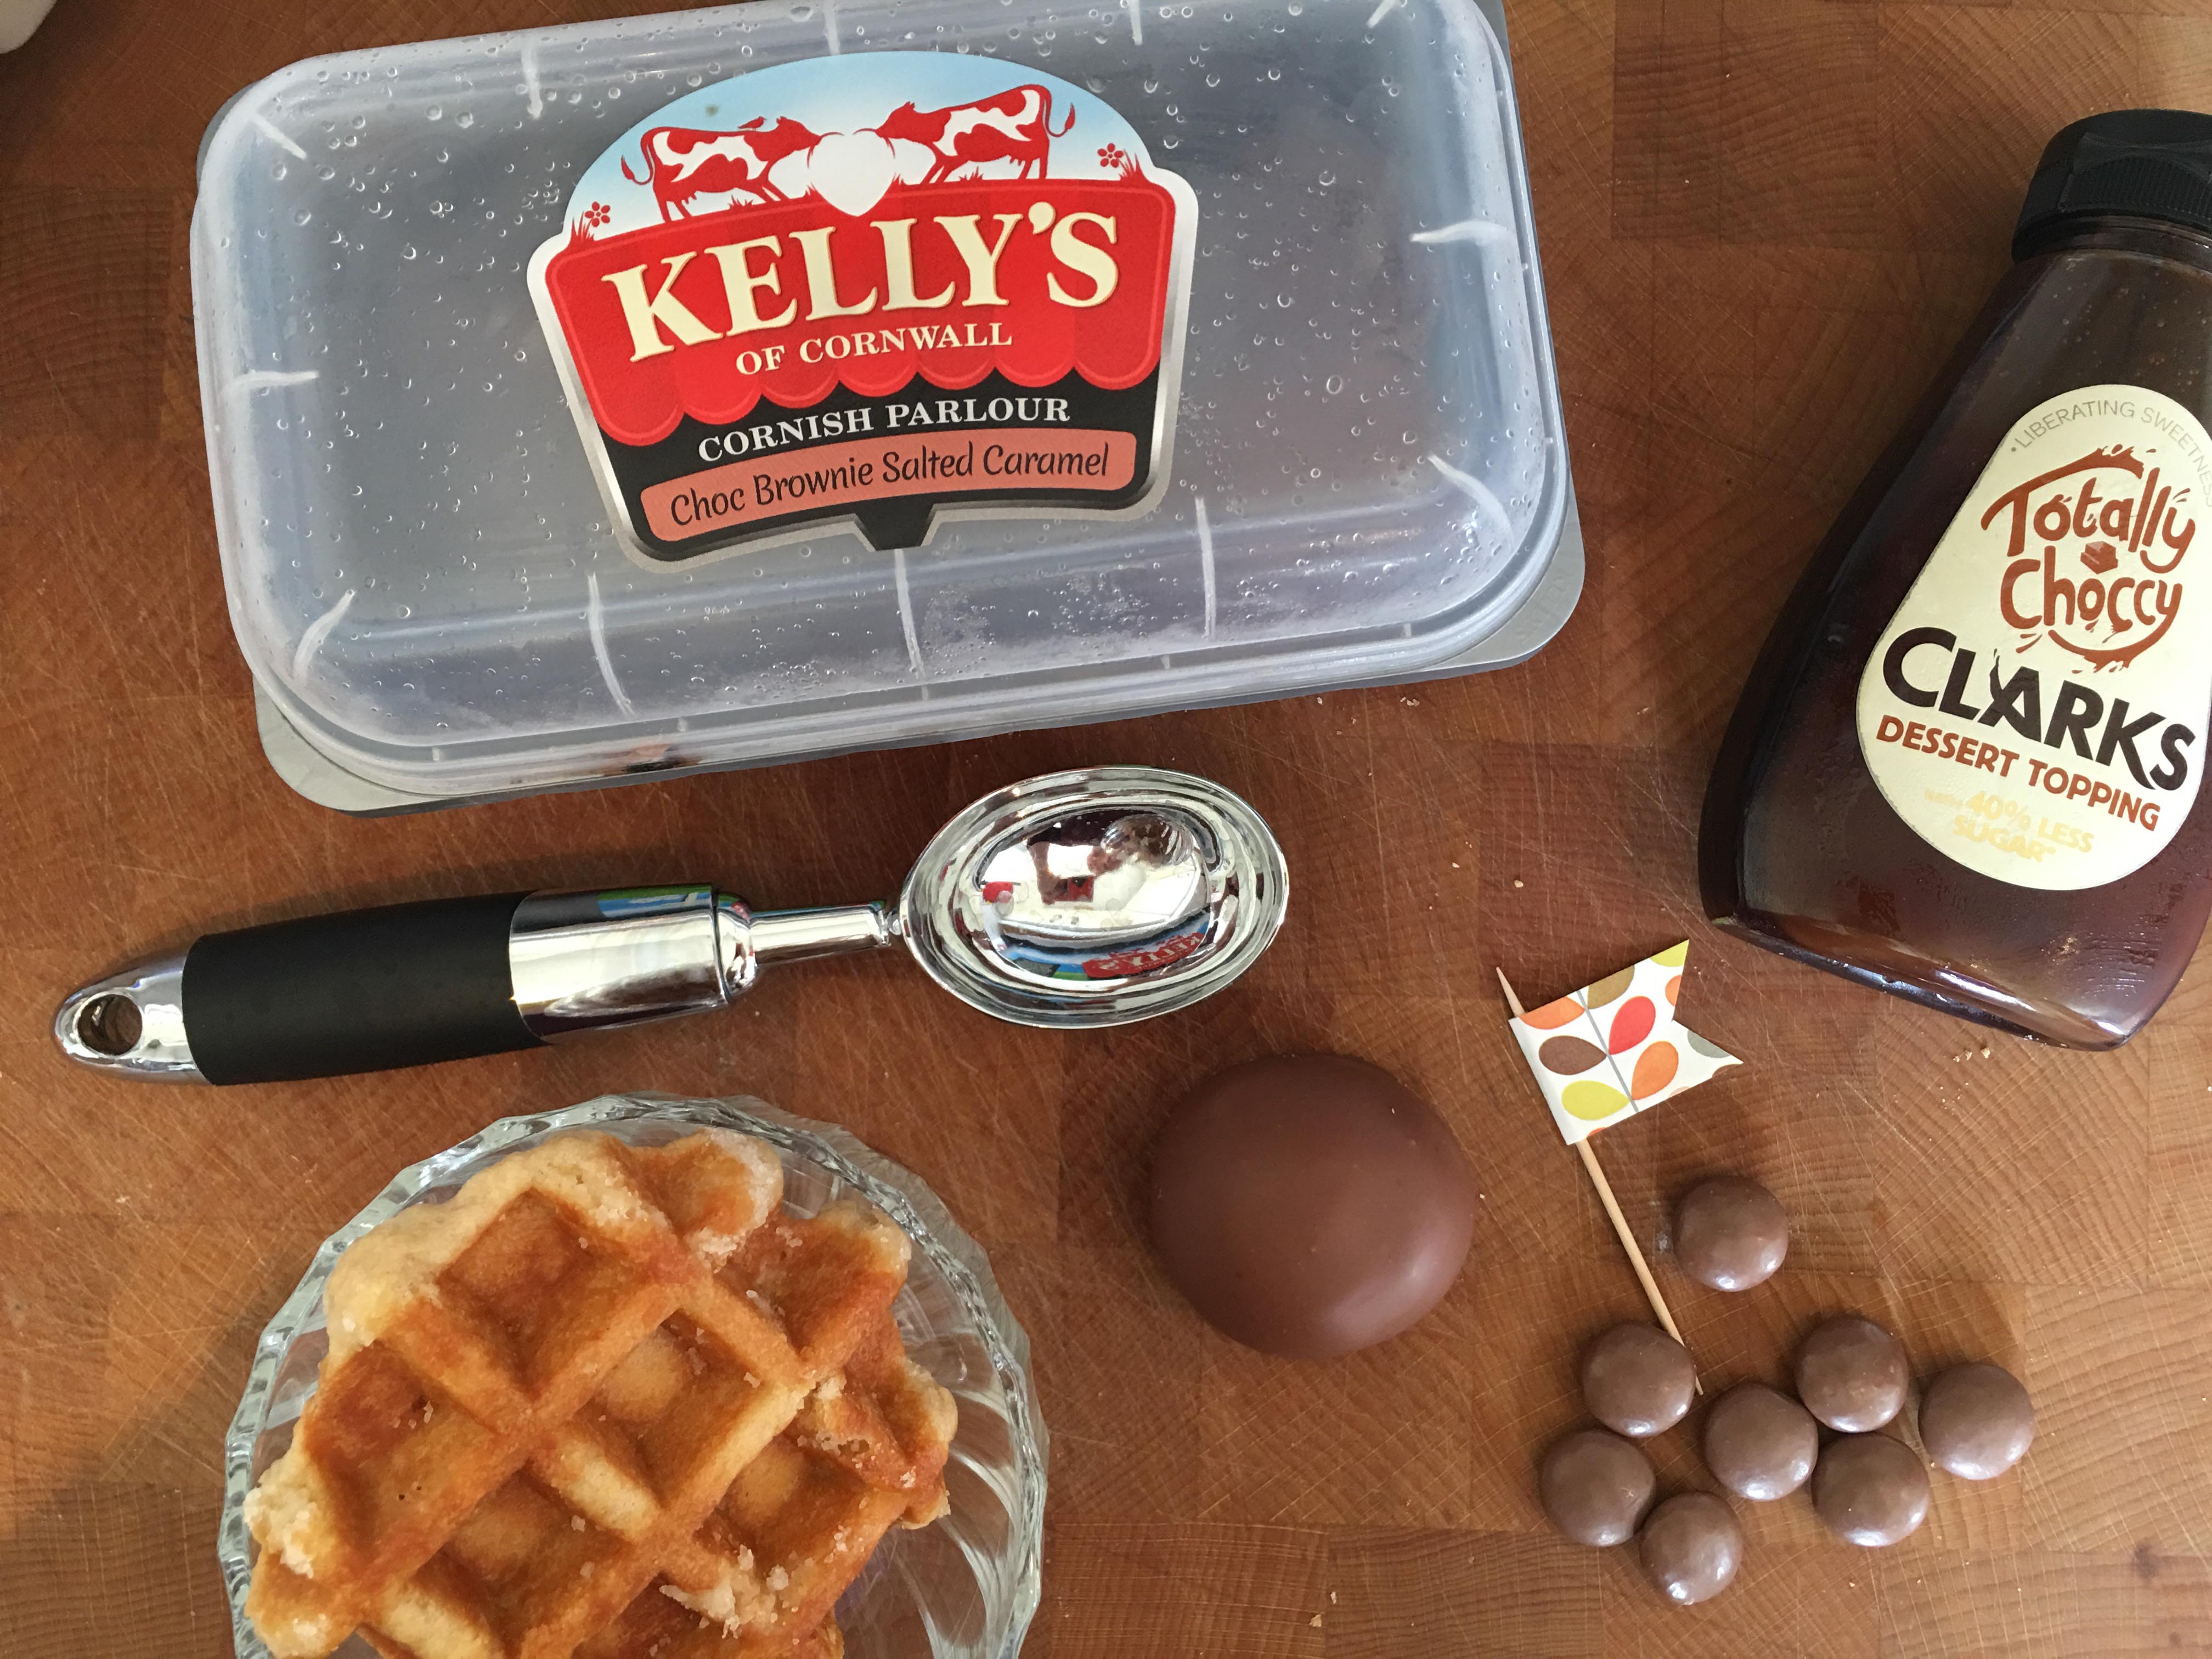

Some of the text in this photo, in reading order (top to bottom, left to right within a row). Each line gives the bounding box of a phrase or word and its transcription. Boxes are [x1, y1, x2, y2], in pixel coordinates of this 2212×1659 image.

[602, 201, 1119, 362] KELLY'S
[736, 323, 1012, 375] OF CORNWALL
[698, 398, 1070, 462] CORNISH PARLOUR
[2015, 400, 2135, 449] LIBERATING
[670, 441, 1109, 526] Choc Brownie Salted Caramel
[1981, 444, 2196, 574] Totally
[2000, 545, 2183, 673] Choccy
[1883, 627, 2196, 791] CLARKS
[1876, 715, 2160, 831] DESSERT TOPPING
[2038, 817, 2095, 853] LESS
